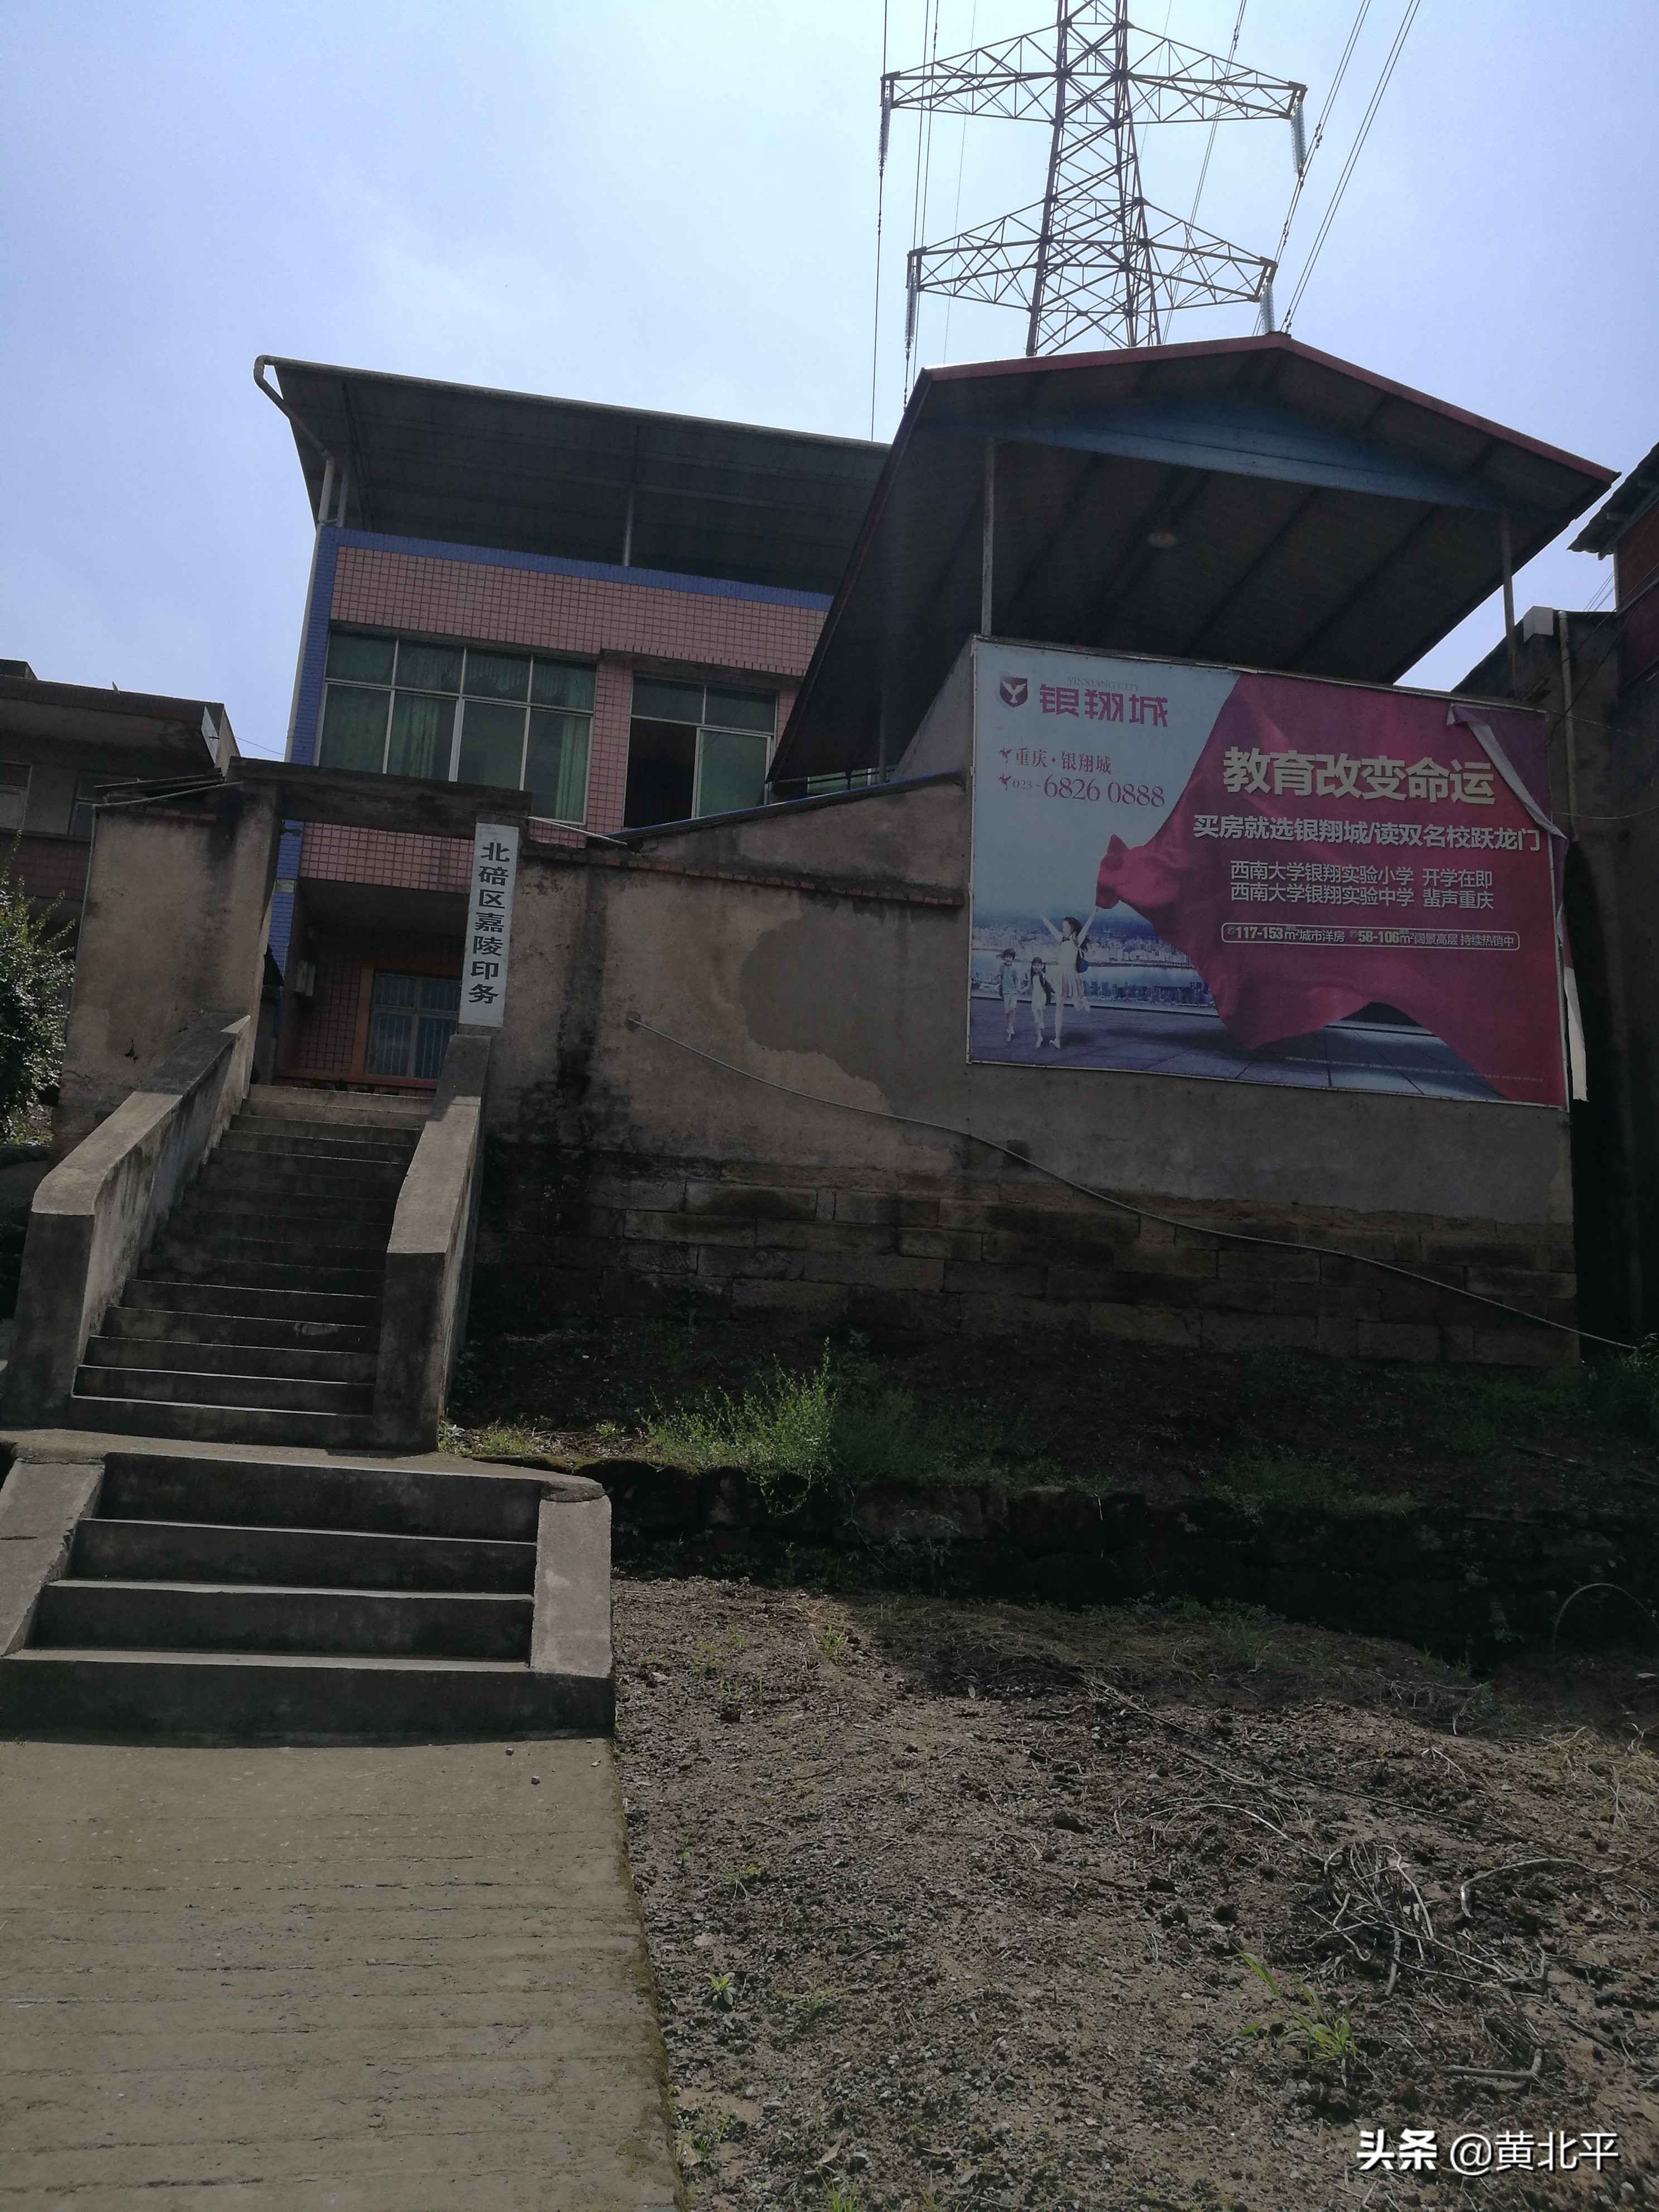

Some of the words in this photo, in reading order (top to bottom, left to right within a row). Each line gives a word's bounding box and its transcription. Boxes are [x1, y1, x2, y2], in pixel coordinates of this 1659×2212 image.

[1067, 676, 1115, 689] YINXIANG
[1118, 682, 1141, 691] CITY
[1040, 683, 1168, 727] 银翔城
[1223, 746, 1496, 805] 教育改变命运
[1107, 782, 1165, 807] 0888
[1193, 814, 1540, 852] 买房就选银翔城/读双名校跃龙门
[1230, 860, 1414, 885] 西南大学银翔实验小学
[1422, 868, 1493, 889] 开学在即
[1230, 882, 1415, 907] 西南大学银翔实验中学
[468, 842, 510, 1005] 北碚区嘉陵印务
